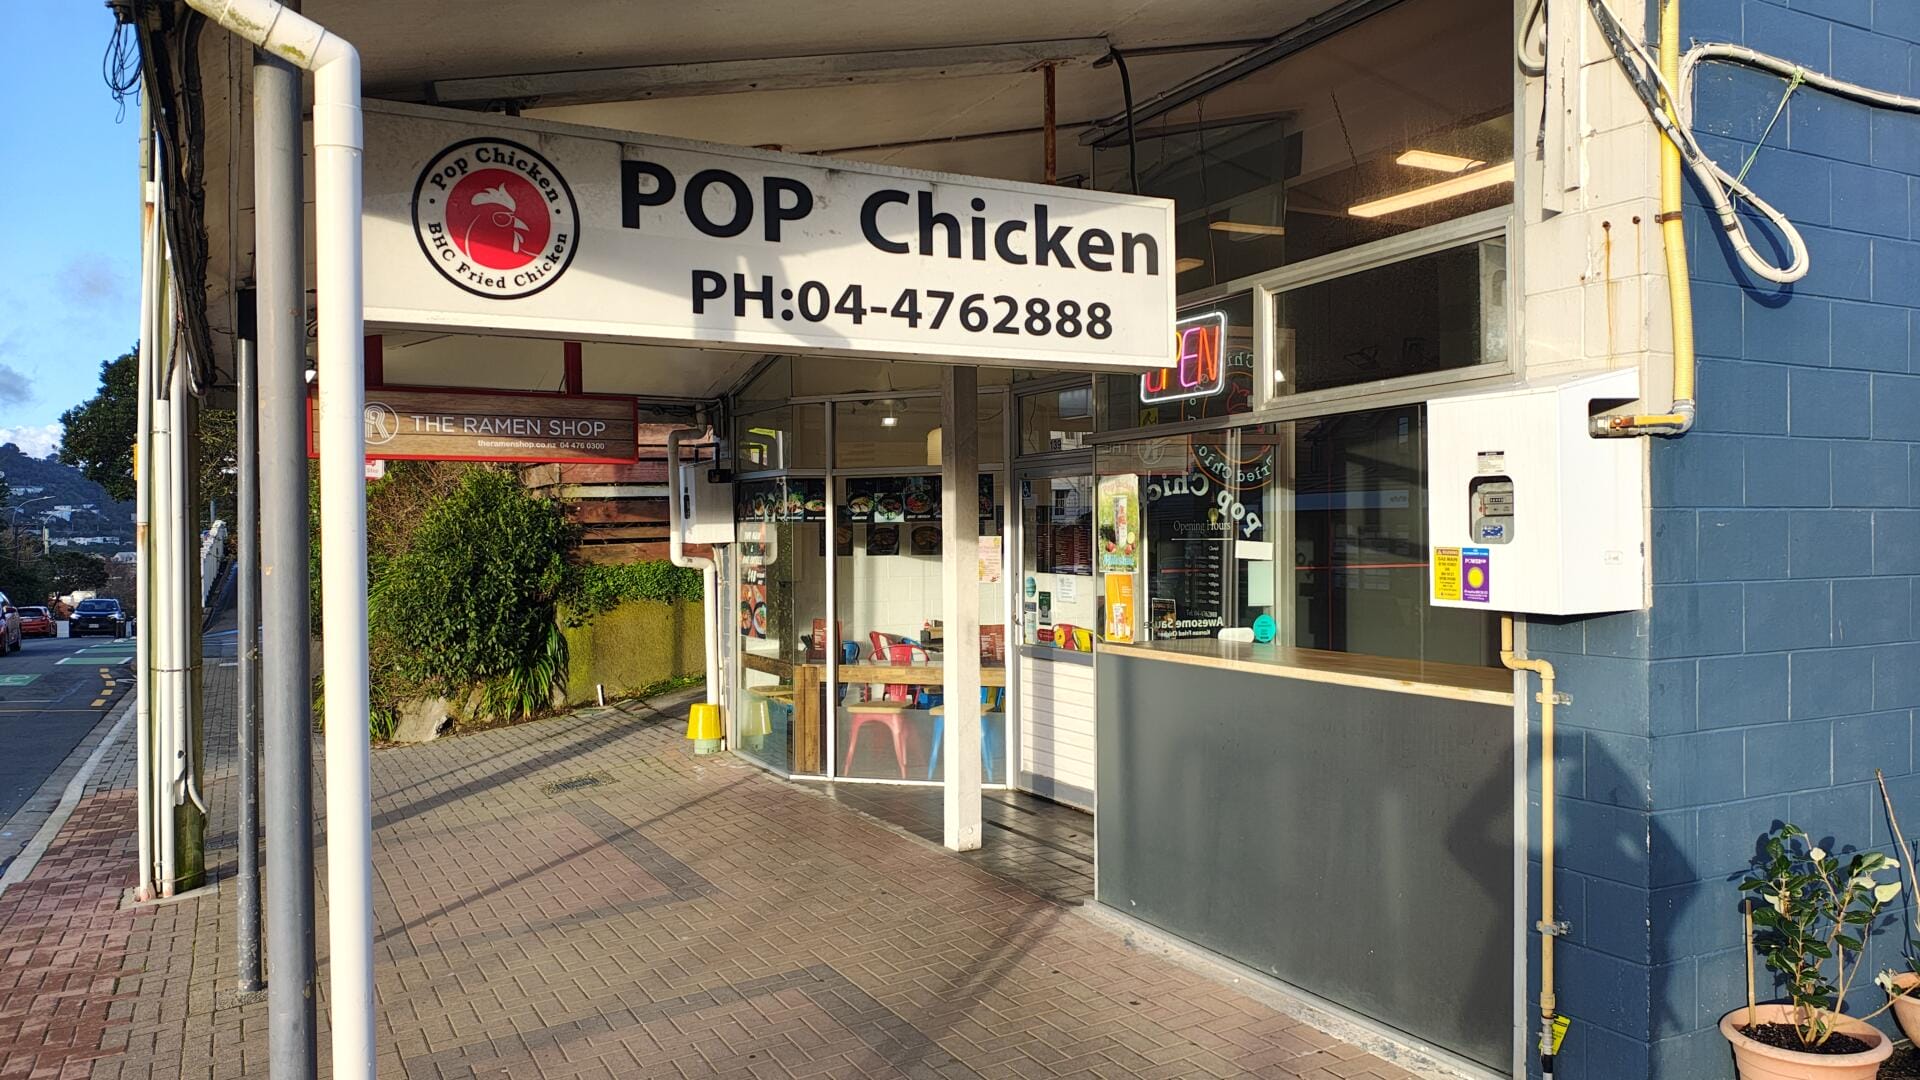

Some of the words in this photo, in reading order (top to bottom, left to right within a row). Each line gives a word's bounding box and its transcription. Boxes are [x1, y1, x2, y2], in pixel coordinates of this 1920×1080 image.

[430, 156, 469, 191] Pop
[475, 147, 561, 204] Chicken
[621, 160, 814, 242] POP
[859, 189, 1160, 276] Chicken
[427, 221, 456, 262] BHC
[456, 262, 507, 289] Fried
[514, 231, 568, 288] Chicken
[691, 270, 1113, 341] PH:04-4762888
[411, 415, 455, 433] THE
[463, 416, 541, 436] RAMEN
[549, 419, 606, 437] SHOP
[477, 439, 556, 450] theramenshop.co.nz
[1173, 520, 1205, 535] Opening
[1207, 519, 1232, 531] Hours
